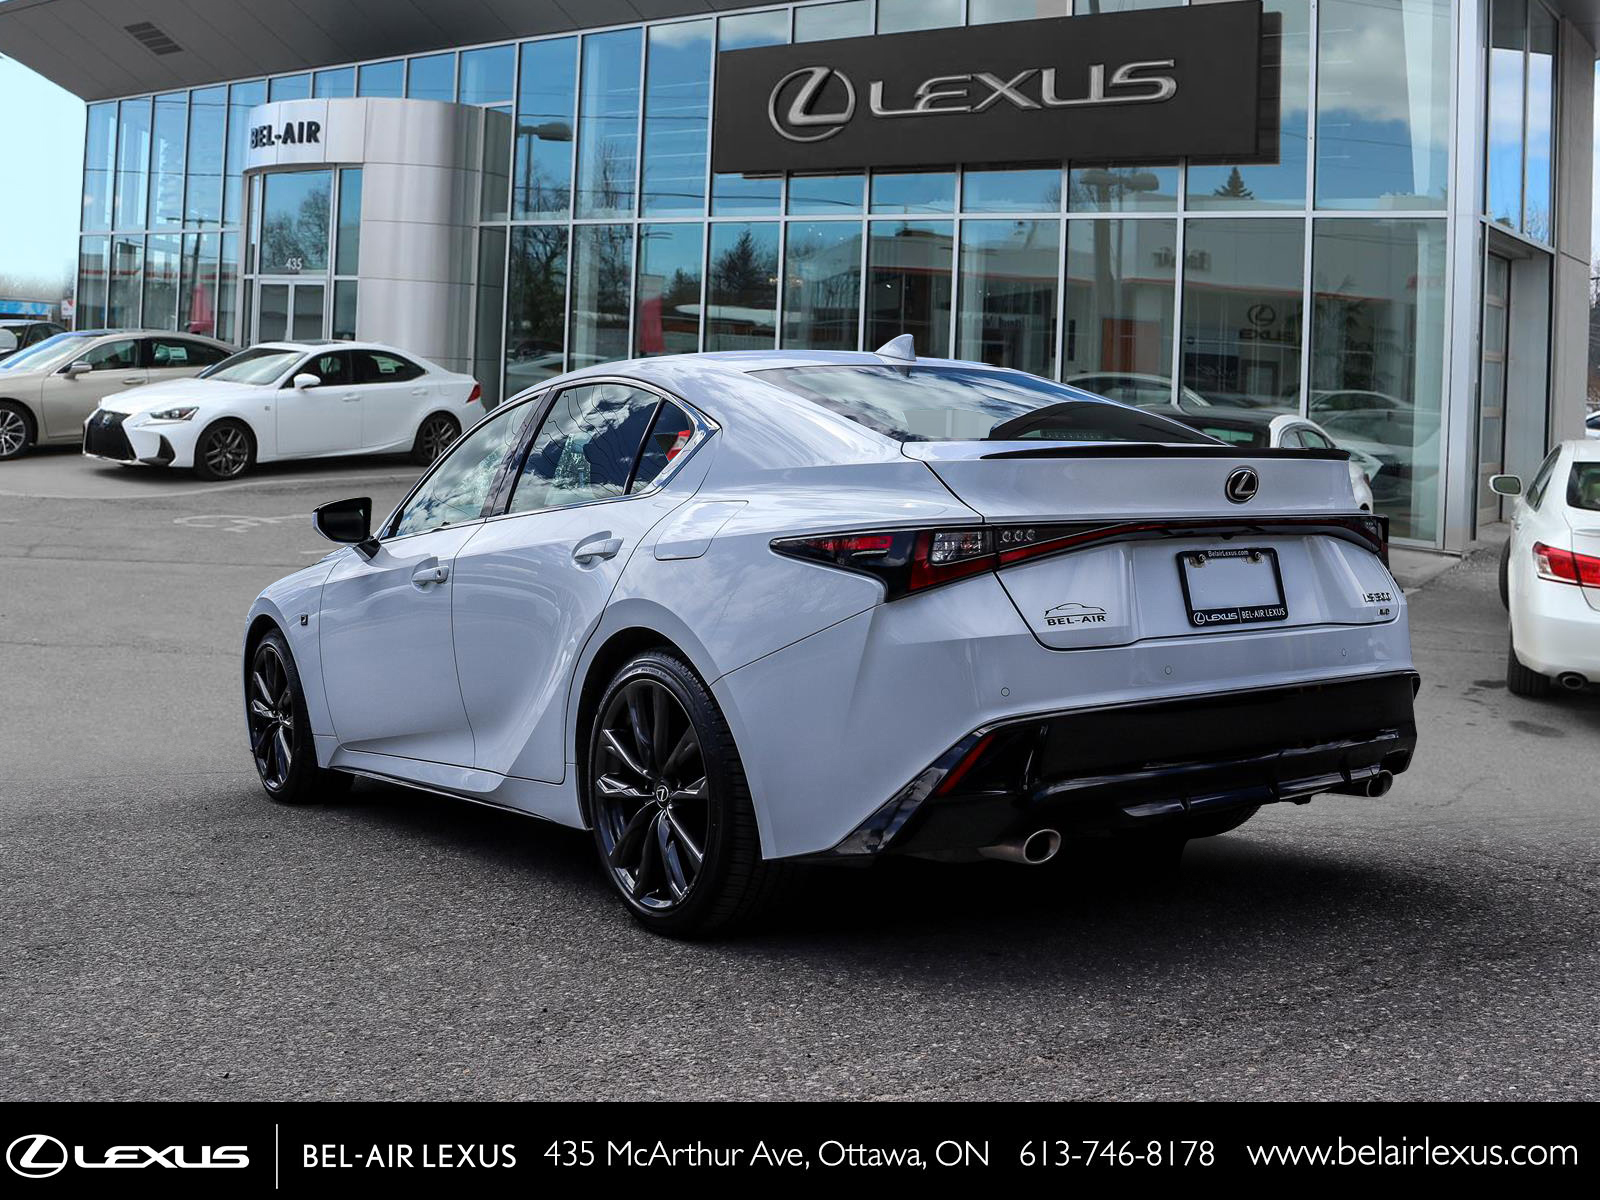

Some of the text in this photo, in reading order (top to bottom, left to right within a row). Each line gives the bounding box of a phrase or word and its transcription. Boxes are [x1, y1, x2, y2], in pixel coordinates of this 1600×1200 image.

[869, 58, 1178, 117] LEXUS
[250, 121, 321, 149] BEL-AIR
[286, 257, 302, 271] 435
[1207, 550, 1249, 558] BelairLexus.com
[1205, 612, 1238, 622] LEXUS
[1241, 607, 1286, 619] BEL-AIR LEXUS
[1046, 614, 1107, 627] BEL-AIR
